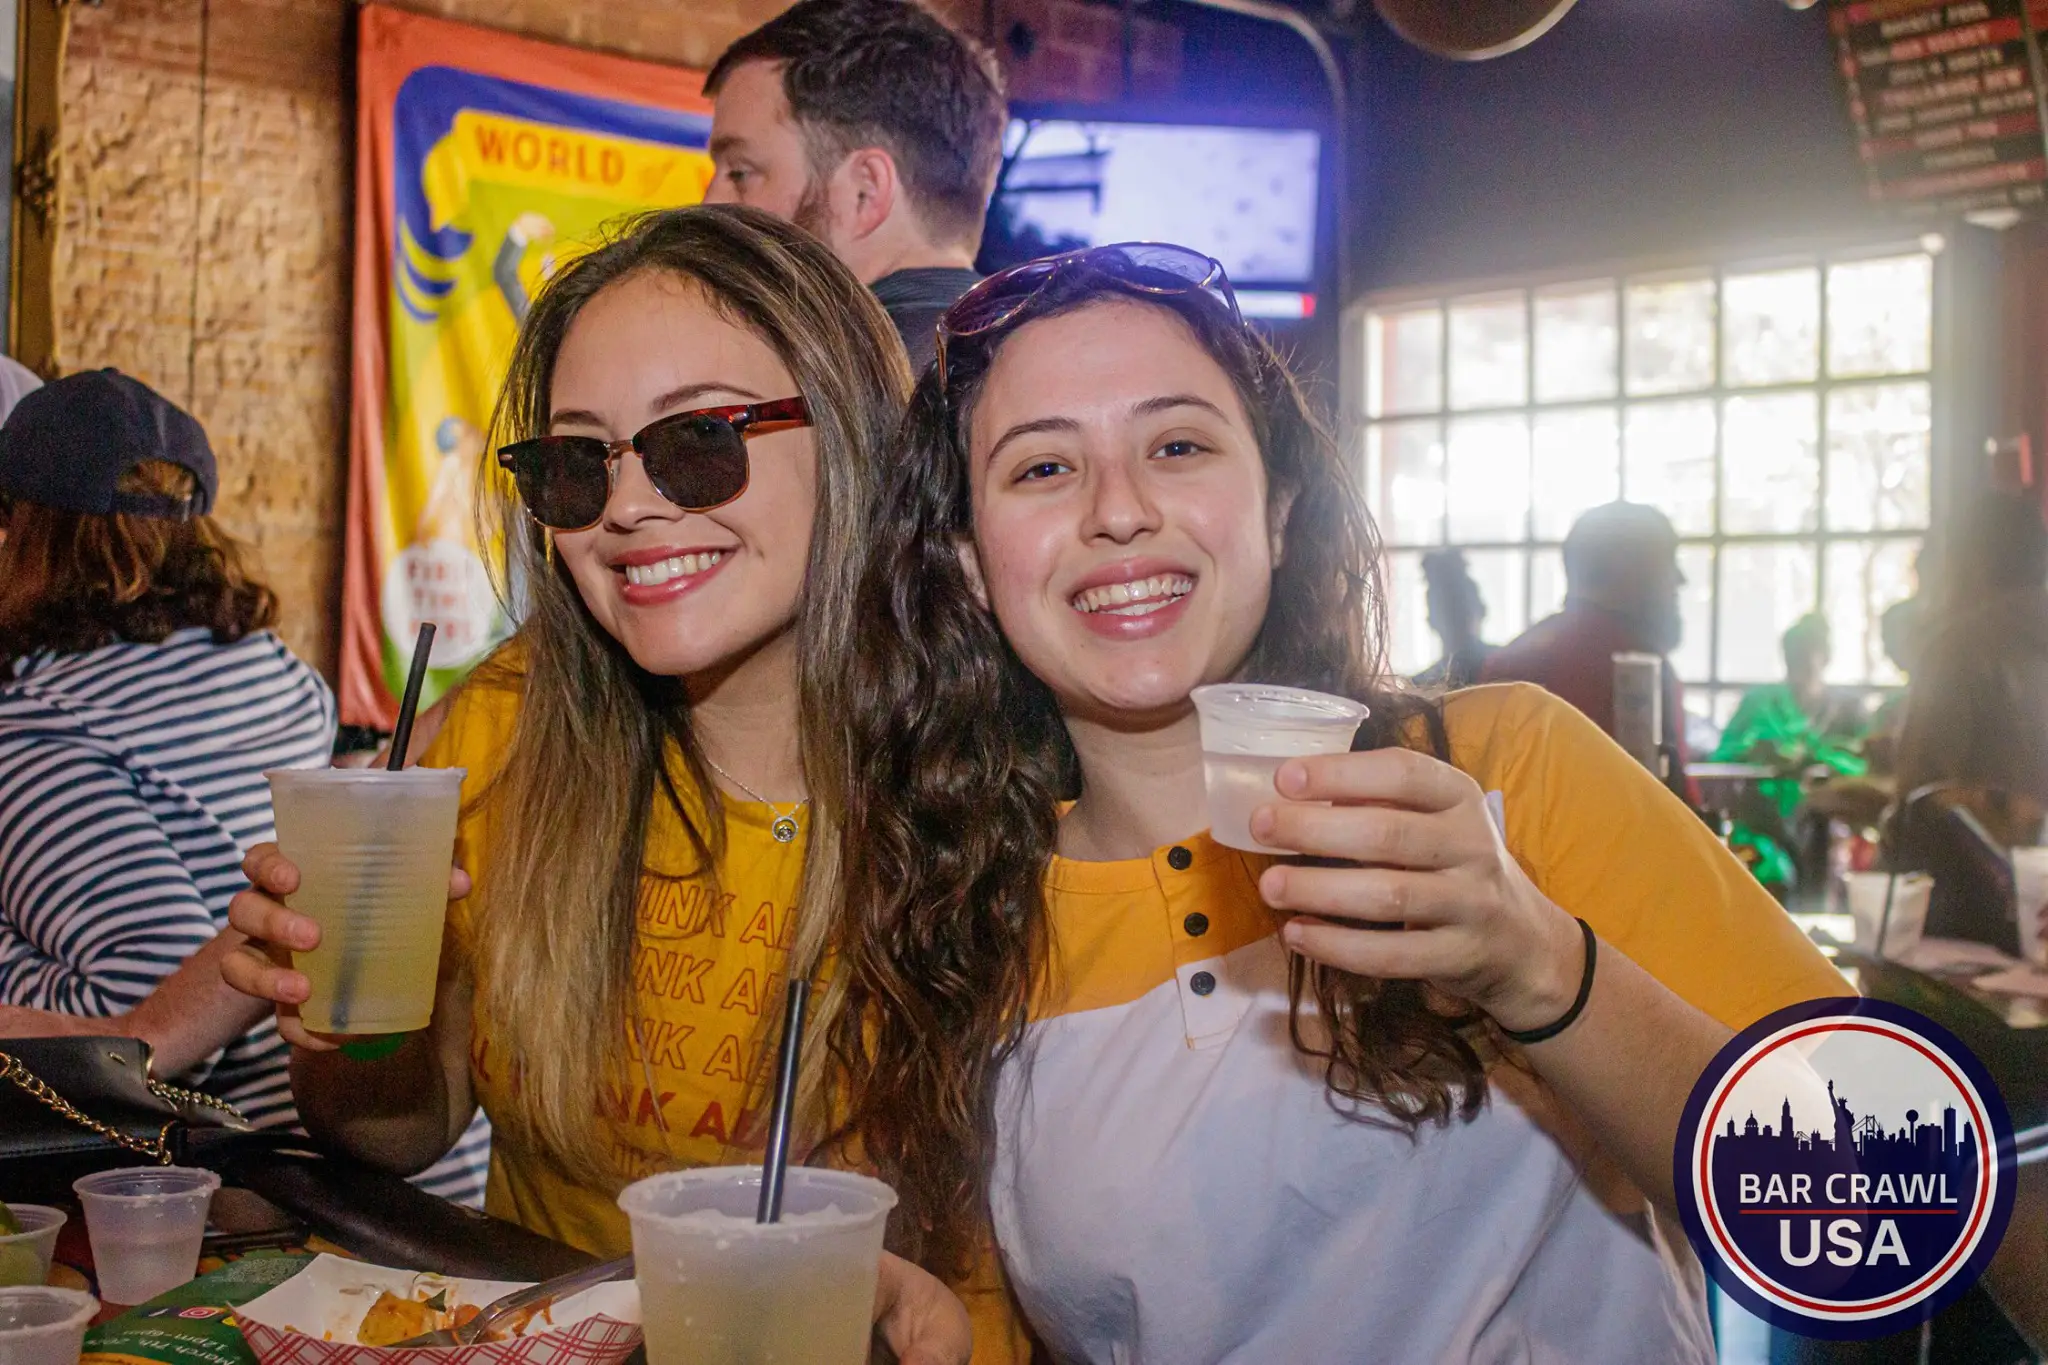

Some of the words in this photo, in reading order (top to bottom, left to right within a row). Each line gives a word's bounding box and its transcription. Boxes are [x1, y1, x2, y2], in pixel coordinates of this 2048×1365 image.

[474, 124, 626, 187] WORLD
[635, 877, 736, 938] INK
[632, 947, 715, 1004] NK
